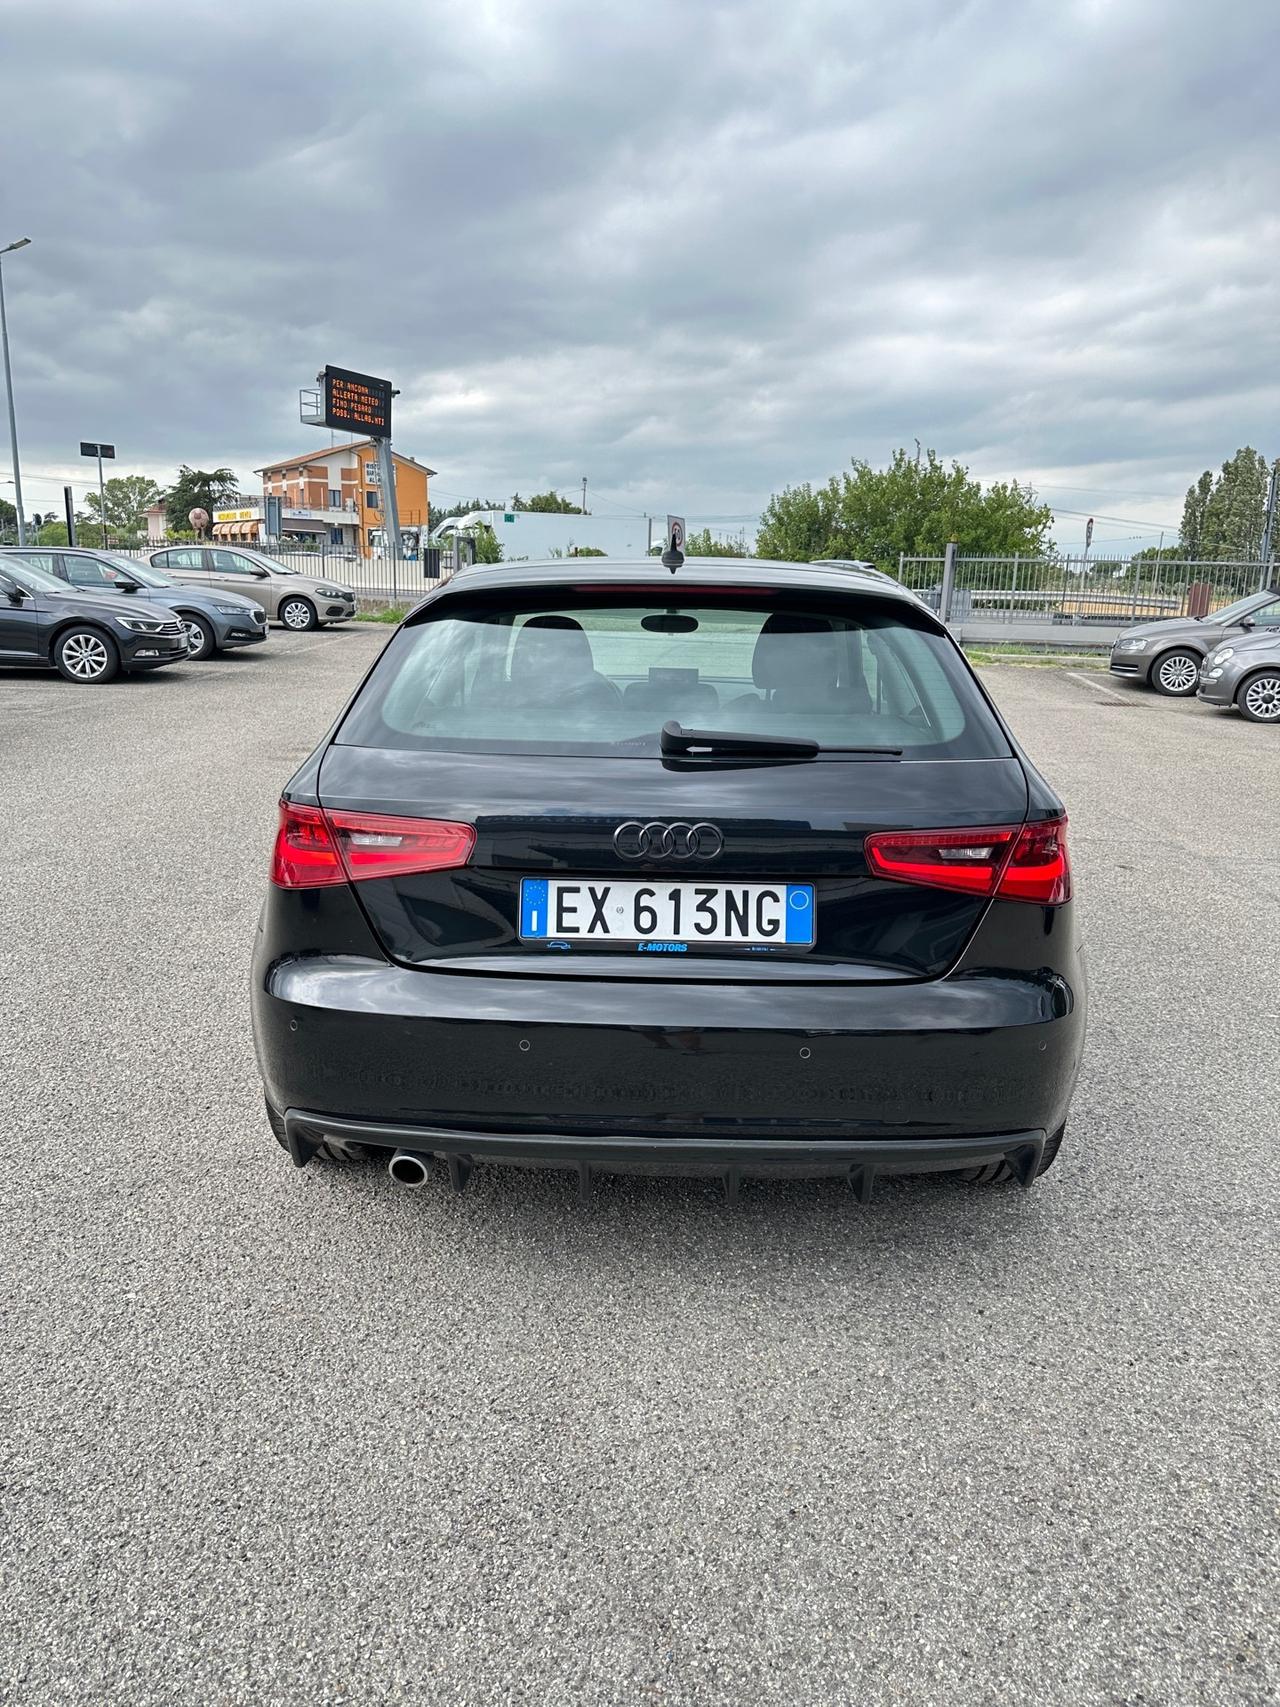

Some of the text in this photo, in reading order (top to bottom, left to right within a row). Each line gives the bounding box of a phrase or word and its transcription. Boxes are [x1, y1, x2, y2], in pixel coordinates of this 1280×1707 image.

[332, 379, 369, 394] PER ANCONA
[332, 389, 379, 406] ALLERTA METEO
[332, 398, 371, 413] FINO PESARO
[556, 886, 781, 937] EX 613NG
[638, 942, 688, 952] E-MOTORS
